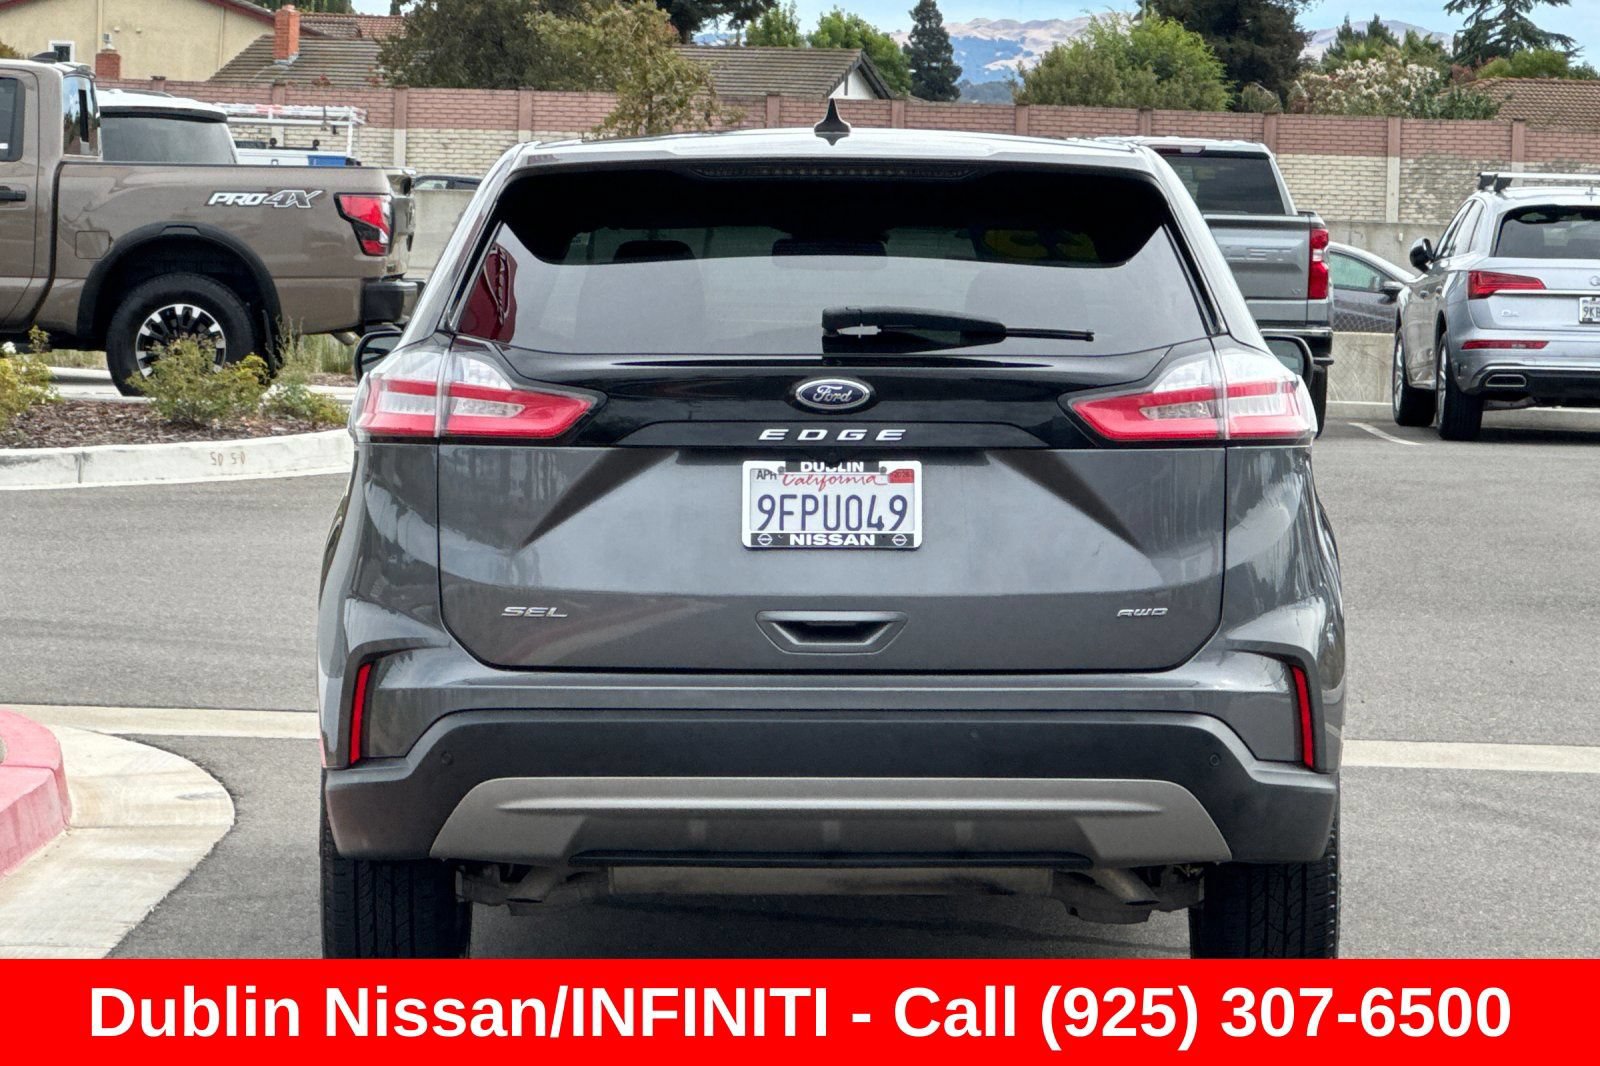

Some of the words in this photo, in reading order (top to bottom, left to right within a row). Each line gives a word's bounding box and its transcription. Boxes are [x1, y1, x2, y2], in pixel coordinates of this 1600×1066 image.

[812, 385, 853, 402] Ford
[758, 429, 906, 441] EDGE
[800, 461, 864, 473] DULIN
[757, 494, 908, 531] 9FPU049
[789, 534, 876, 546] NISSAN
[501, 606, 568, 618] SEL
[1117, 607, 1168, 617] AWD
